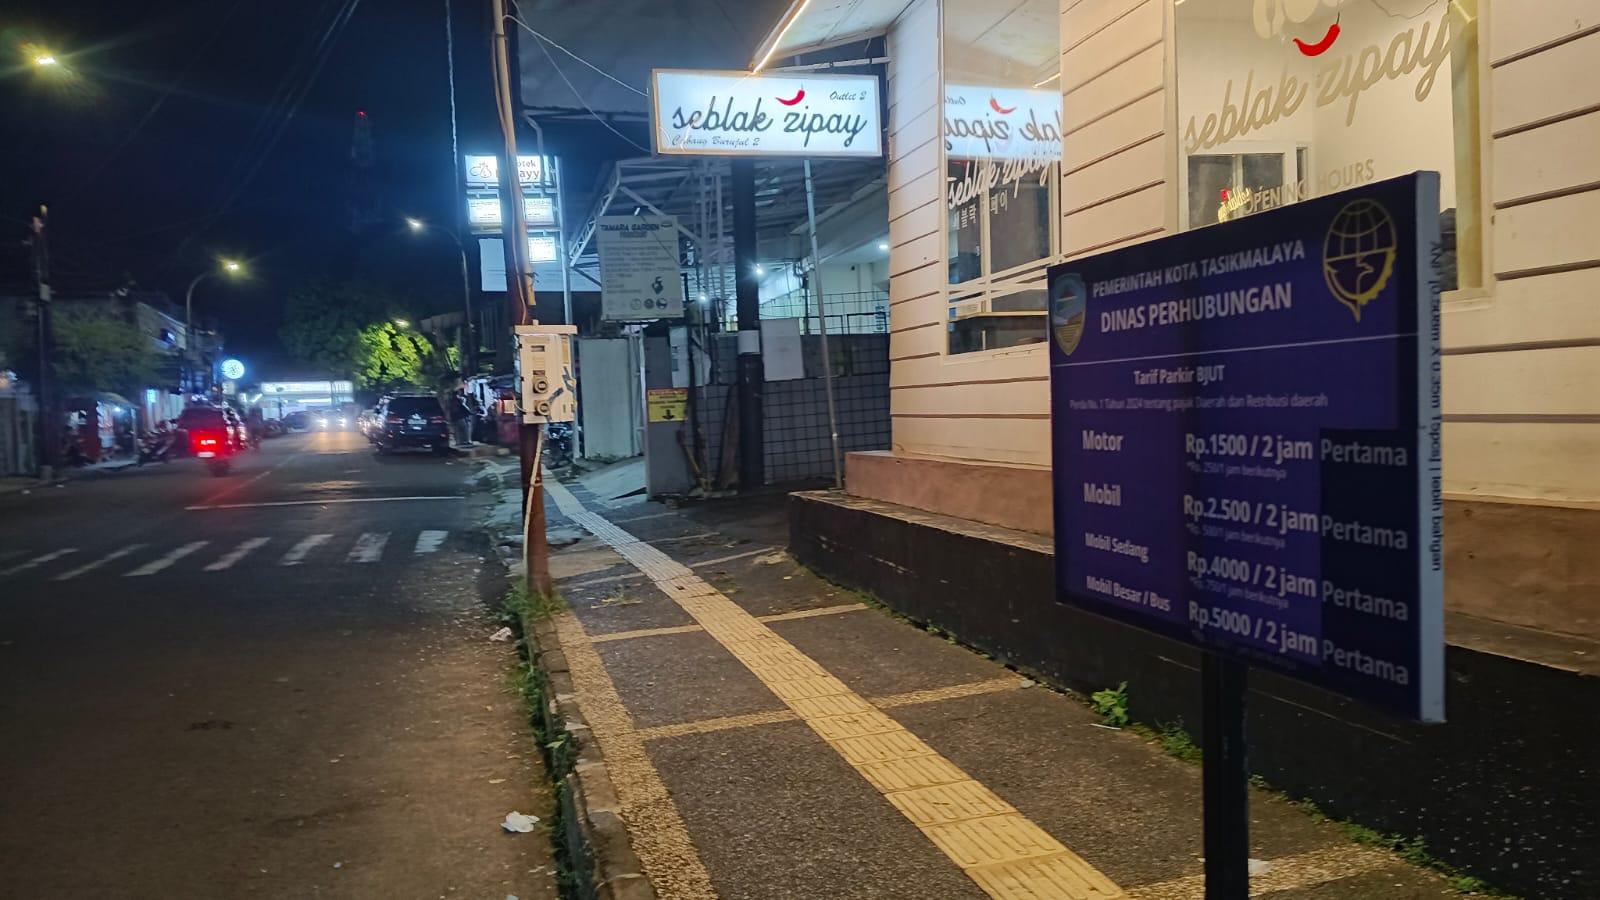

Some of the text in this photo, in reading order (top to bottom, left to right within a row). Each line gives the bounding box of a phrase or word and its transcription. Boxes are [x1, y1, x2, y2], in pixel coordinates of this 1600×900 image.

[830, 90, 856, 101] Outlet
[1184, 12, 1452, 154] seblak zipay
[672, 95, 868, 148] seblak zipay
[948, 155, 1000, 210] seblak
[1244, 178, 1309, 213] OPENING
[1318, 158, 1374, 193] HOURS
[1092, 239, 1305, 298] PEMERINTAH KOTA TASIKMALAYA
[1100, 281, 1293, 334] DINAS PERHUBUNGAN
[1134, 364, 1226, 386] Tarif Parkir BJUT
[1228, 395, 1245, 408] dan
[1246, 394, 1289, 408] Retribusi
[1290, 392, 1328, 408] daerah
[1082, 430, 1408, 467] Motor Rp.1500 / 2 jam Pertama
[1084, 483, 1408, 550] Mobil Rp.2.500 / 2 jam Pertama
[1085, 532, 1408, 622] Mobil Sedang Rp.4000 / 2 jam Pertama
[1086, 574, 1112, 594] Mobil
[1113, 582, 1142, 603] Besar
[1150, 592, 1171, 612] Bus
[1189, 600, 1252, 637] Rp.5000
[1254, 618, 1263, 640] /
[1266, 620, 1278, 645] 2
[1280, 624, 1318, 656] jam
[1322, 639, 1409, 686] Pertama
